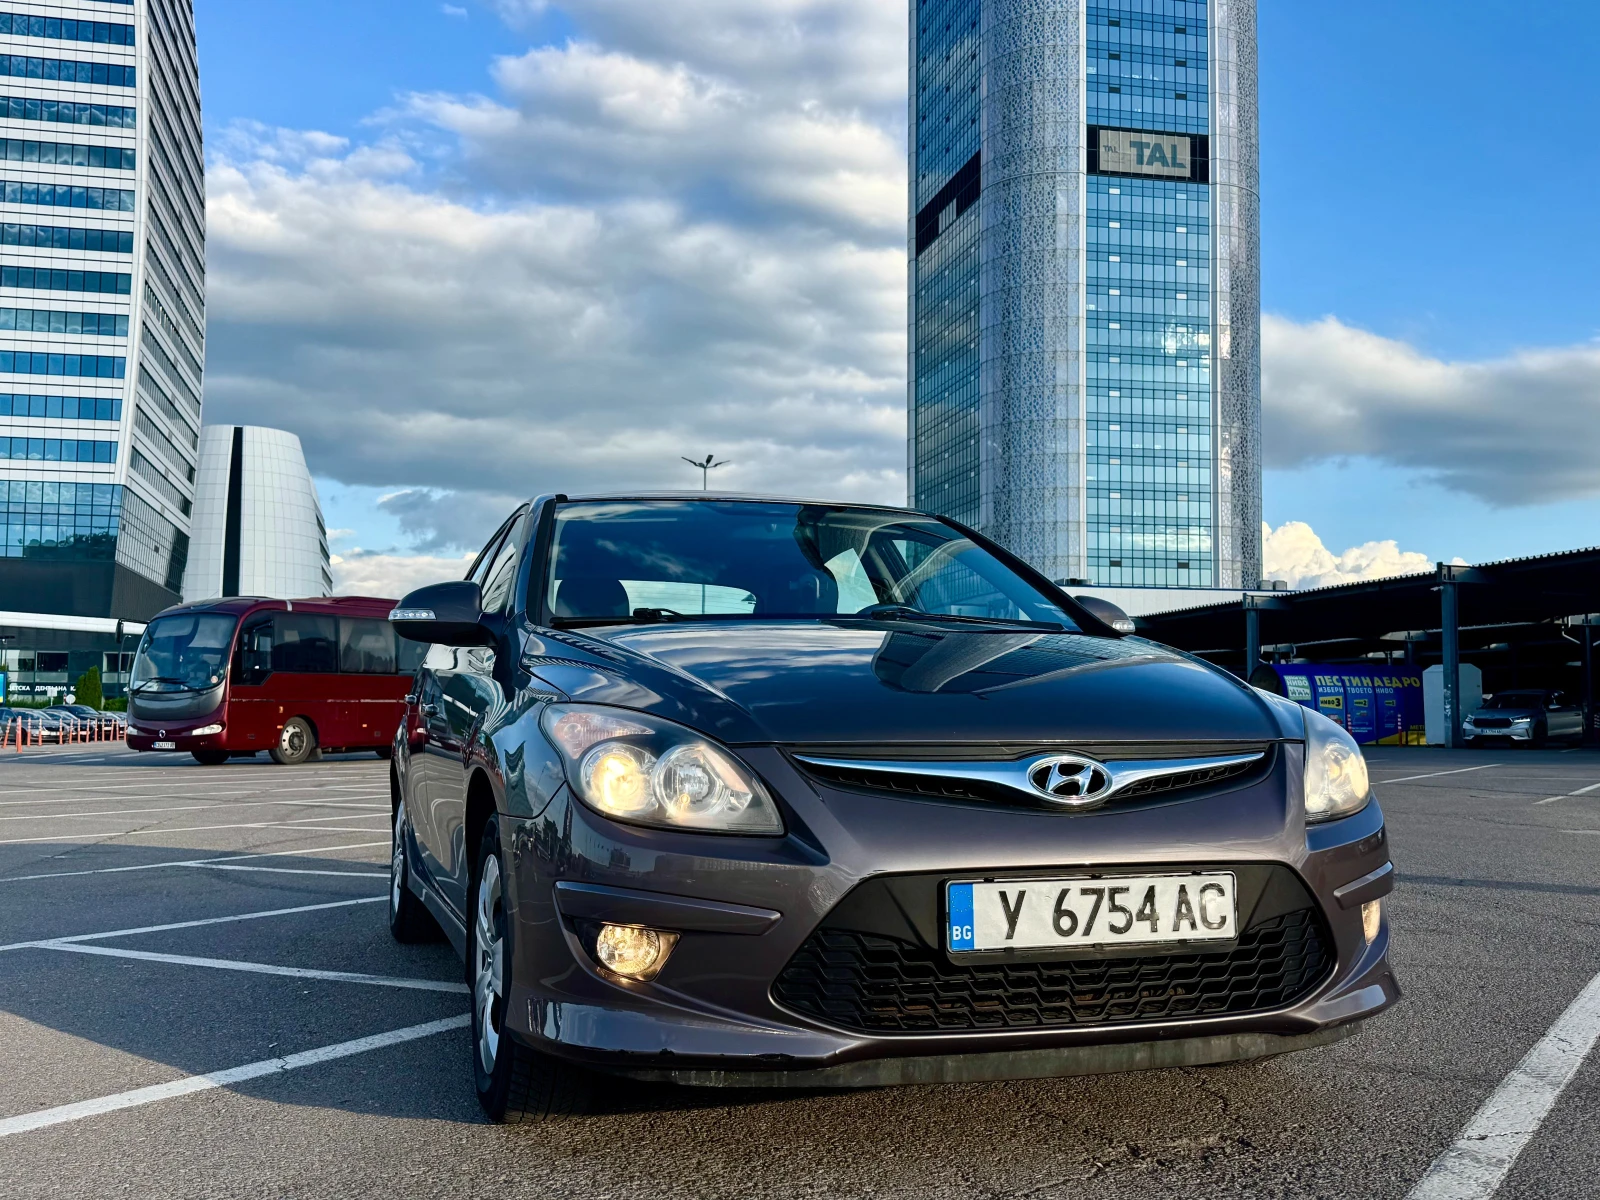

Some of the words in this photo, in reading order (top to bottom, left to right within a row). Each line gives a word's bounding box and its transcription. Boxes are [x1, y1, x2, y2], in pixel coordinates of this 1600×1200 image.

[1102, 144, 1119, 153] TAL
[1129, 140, 1187, 169] TAL
[1335, 697, 1341, 707] 3
[1052, 884, 1160, 937] 6754
[1172, 882, 1227, 932] AC
[952, 925, 972, 941] BG
